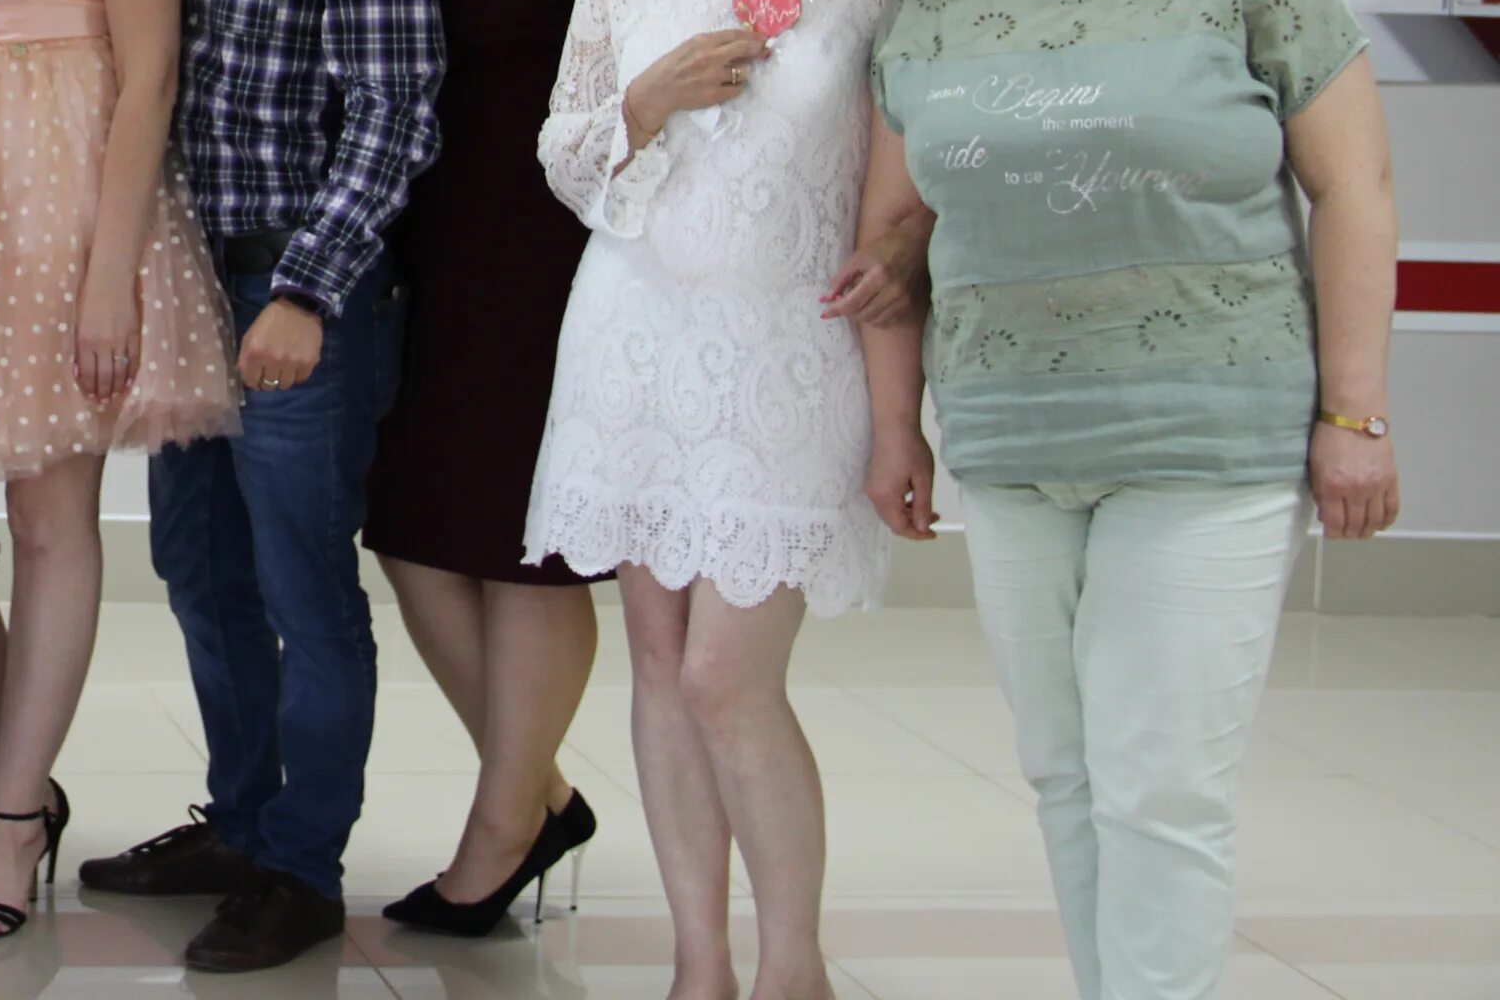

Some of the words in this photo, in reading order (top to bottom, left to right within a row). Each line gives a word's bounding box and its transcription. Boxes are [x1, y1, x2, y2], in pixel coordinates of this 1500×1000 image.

[972, 73, 1106, 119] Begins
[1042, 117, 1067, 131] the
[1070, 114, 1134, 130] moment
[1004, 171, 1020, 185] to
